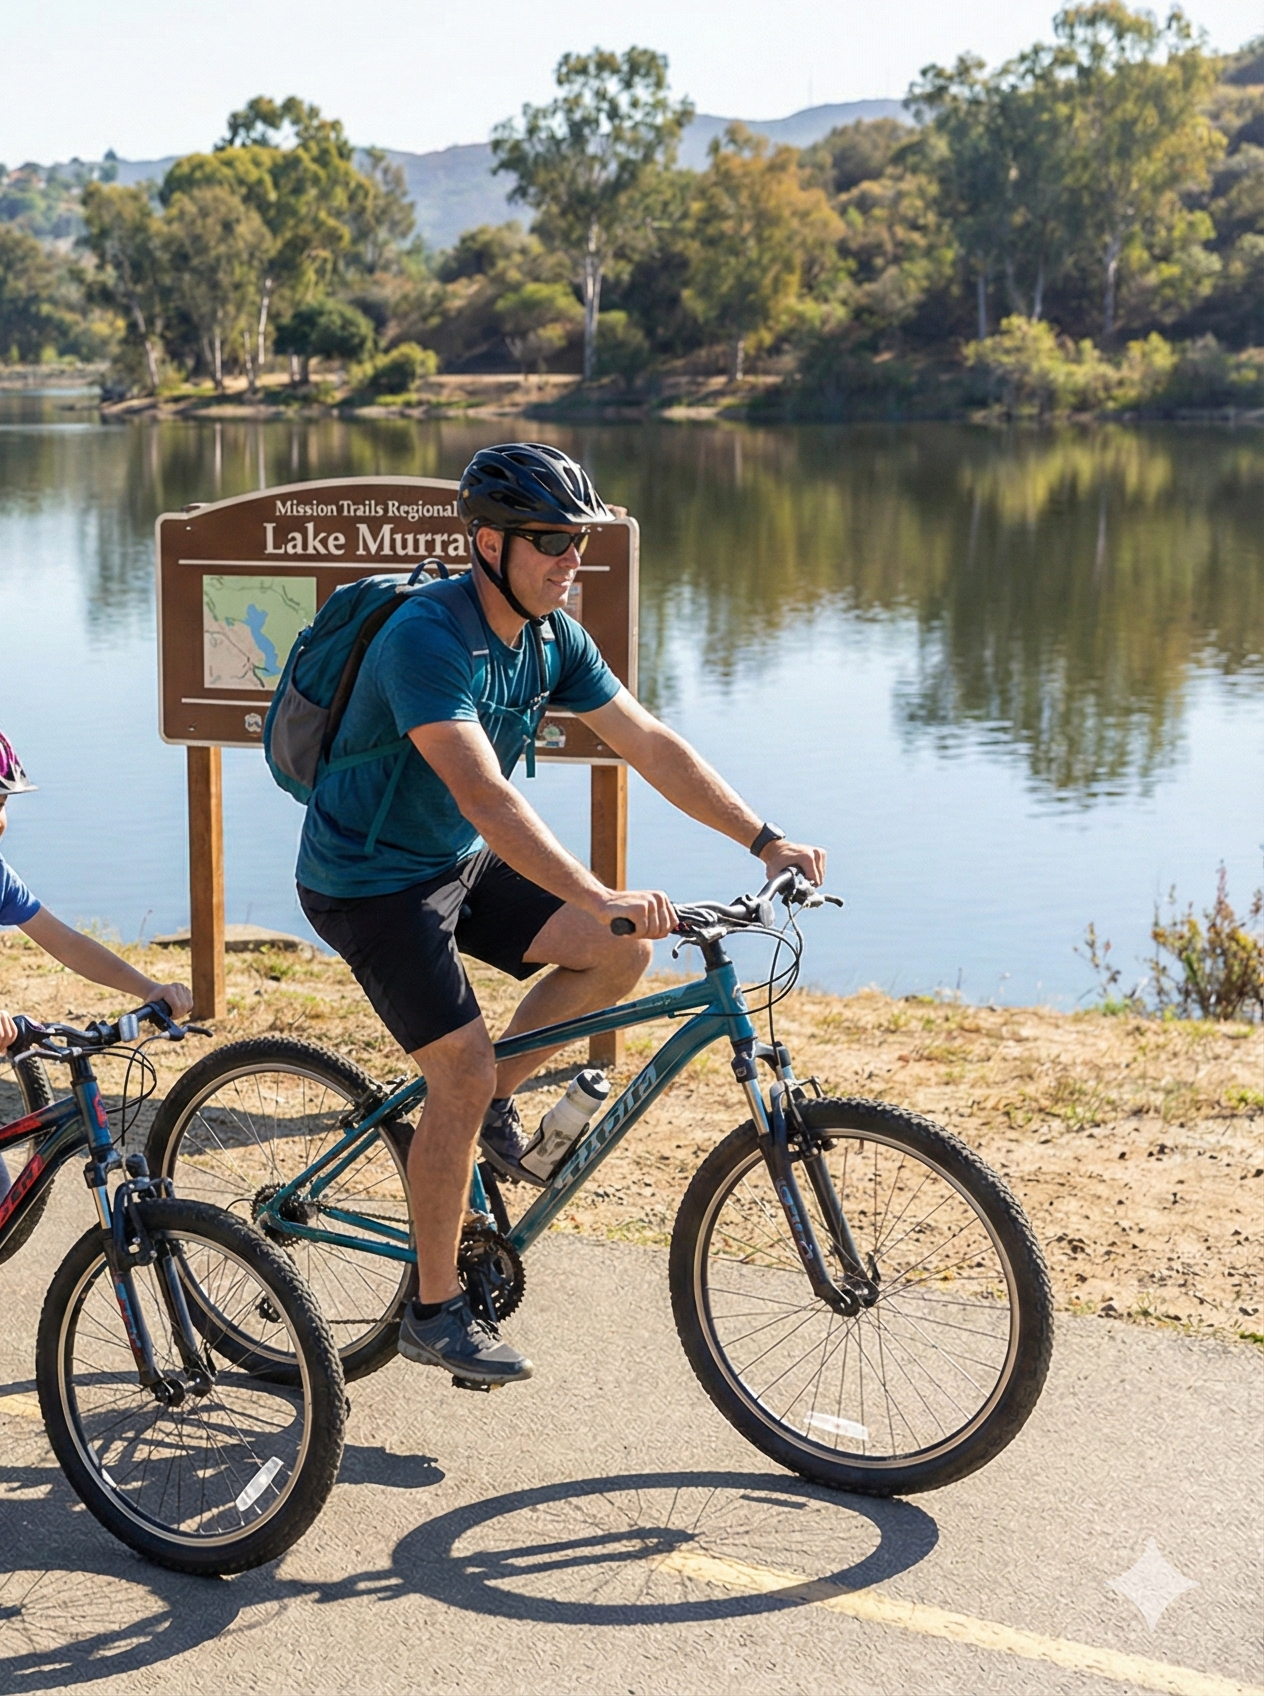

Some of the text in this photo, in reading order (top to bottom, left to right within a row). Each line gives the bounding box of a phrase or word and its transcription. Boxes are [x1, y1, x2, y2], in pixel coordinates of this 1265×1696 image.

[275, 500, 459, 522] Mission Trails Regional
[263, 522, 473, 557] Lake Murra
